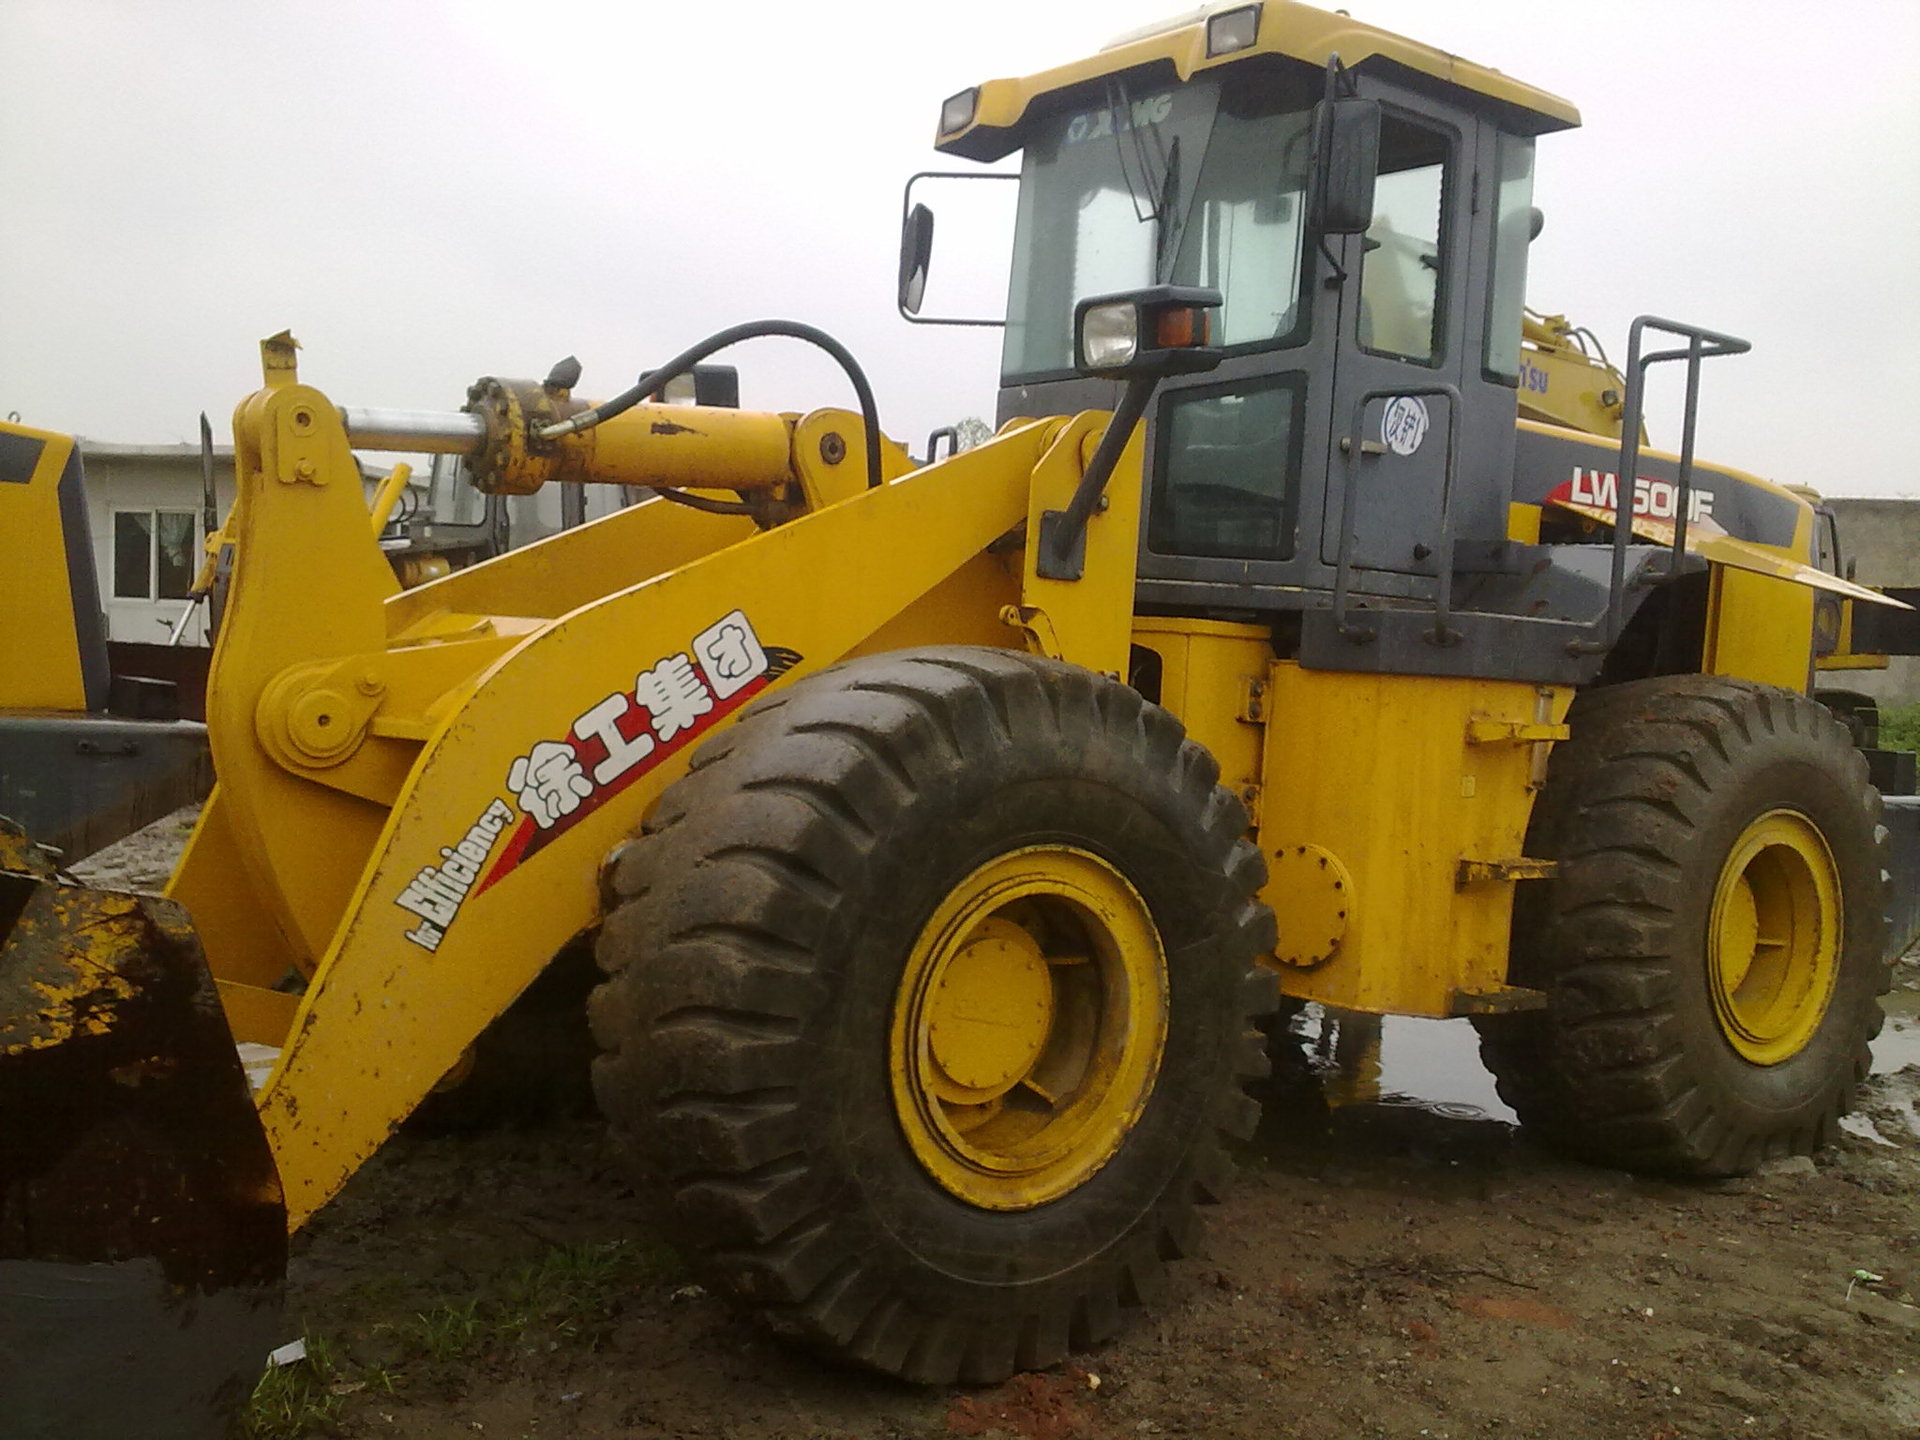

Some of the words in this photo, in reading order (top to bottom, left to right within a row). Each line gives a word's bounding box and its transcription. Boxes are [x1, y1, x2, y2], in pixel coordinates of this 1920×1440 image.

[506, 609, 770, 829] 徐工集团
[394, 797, 516, 927] Efficiency
